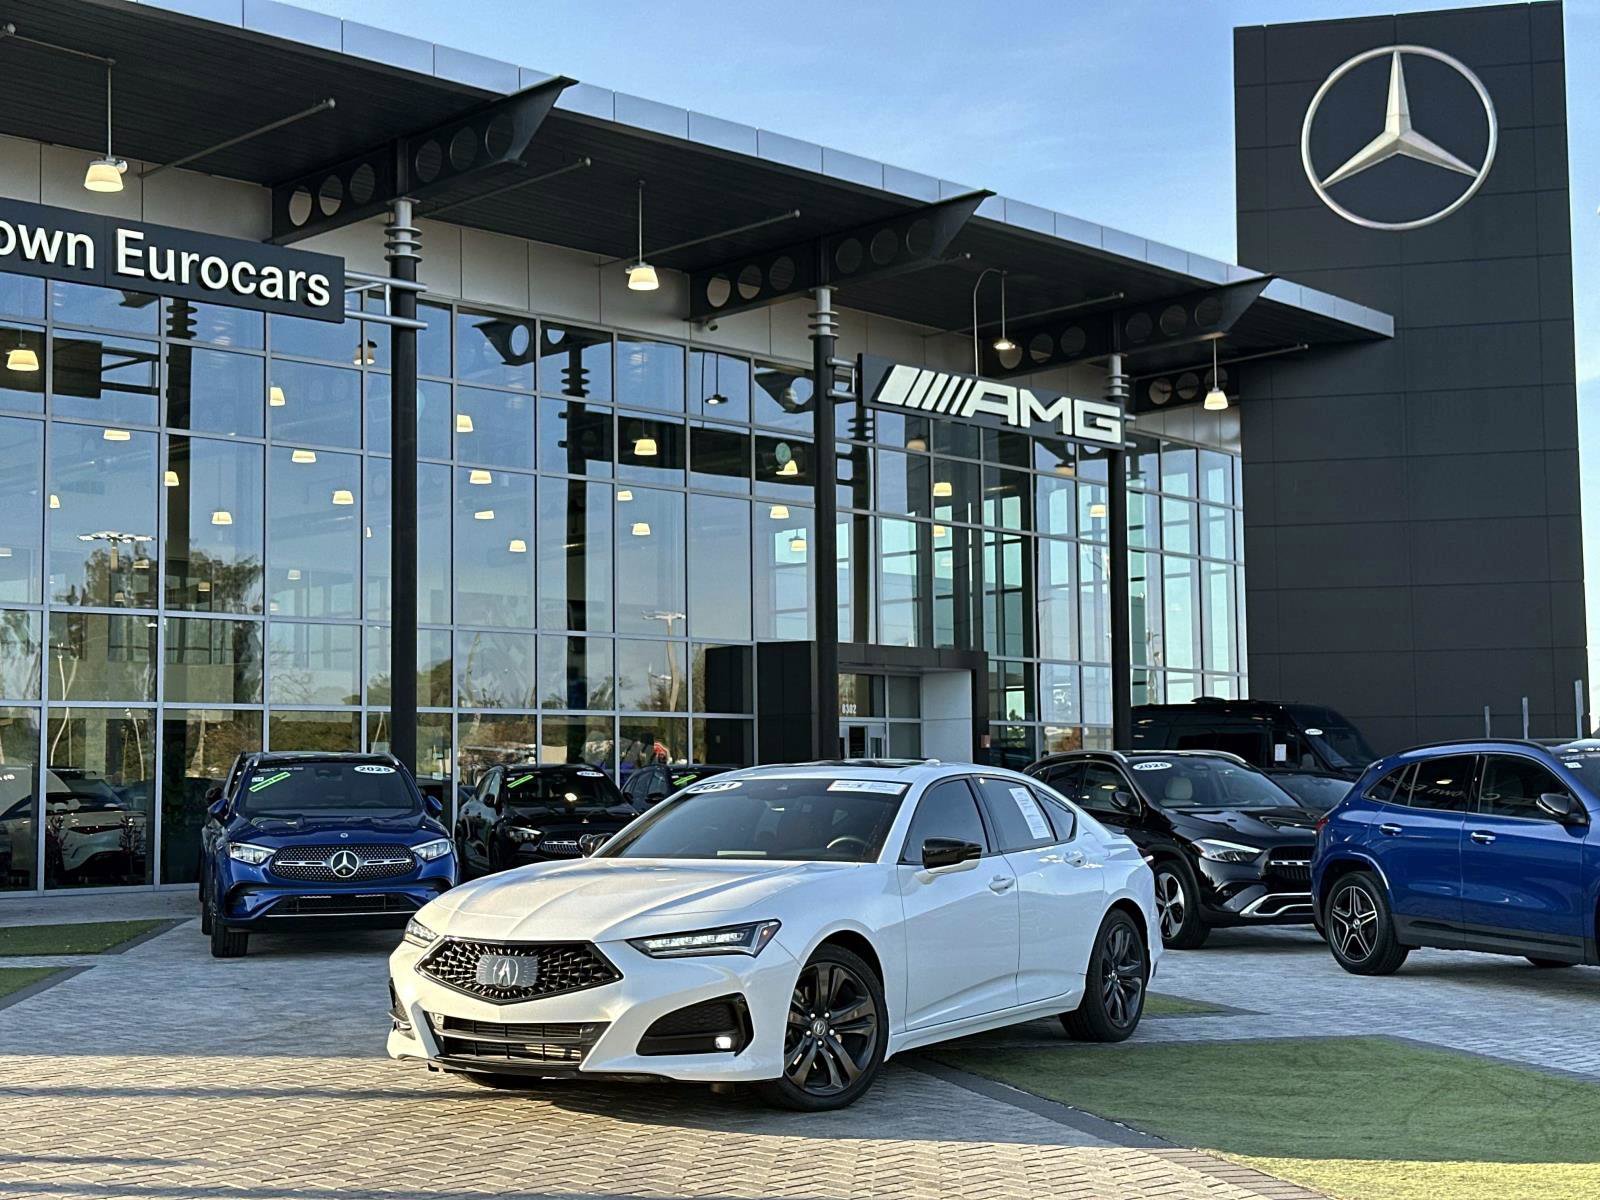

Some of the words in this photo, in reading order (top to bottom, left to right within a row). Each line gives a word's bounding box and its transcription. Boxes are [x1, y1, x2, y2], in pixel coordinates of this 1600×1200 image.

[117, 228, 330, 306] Eurocars
[961, 380, 1121, 444] AMG
[692, 782, 736, 791] 2021
